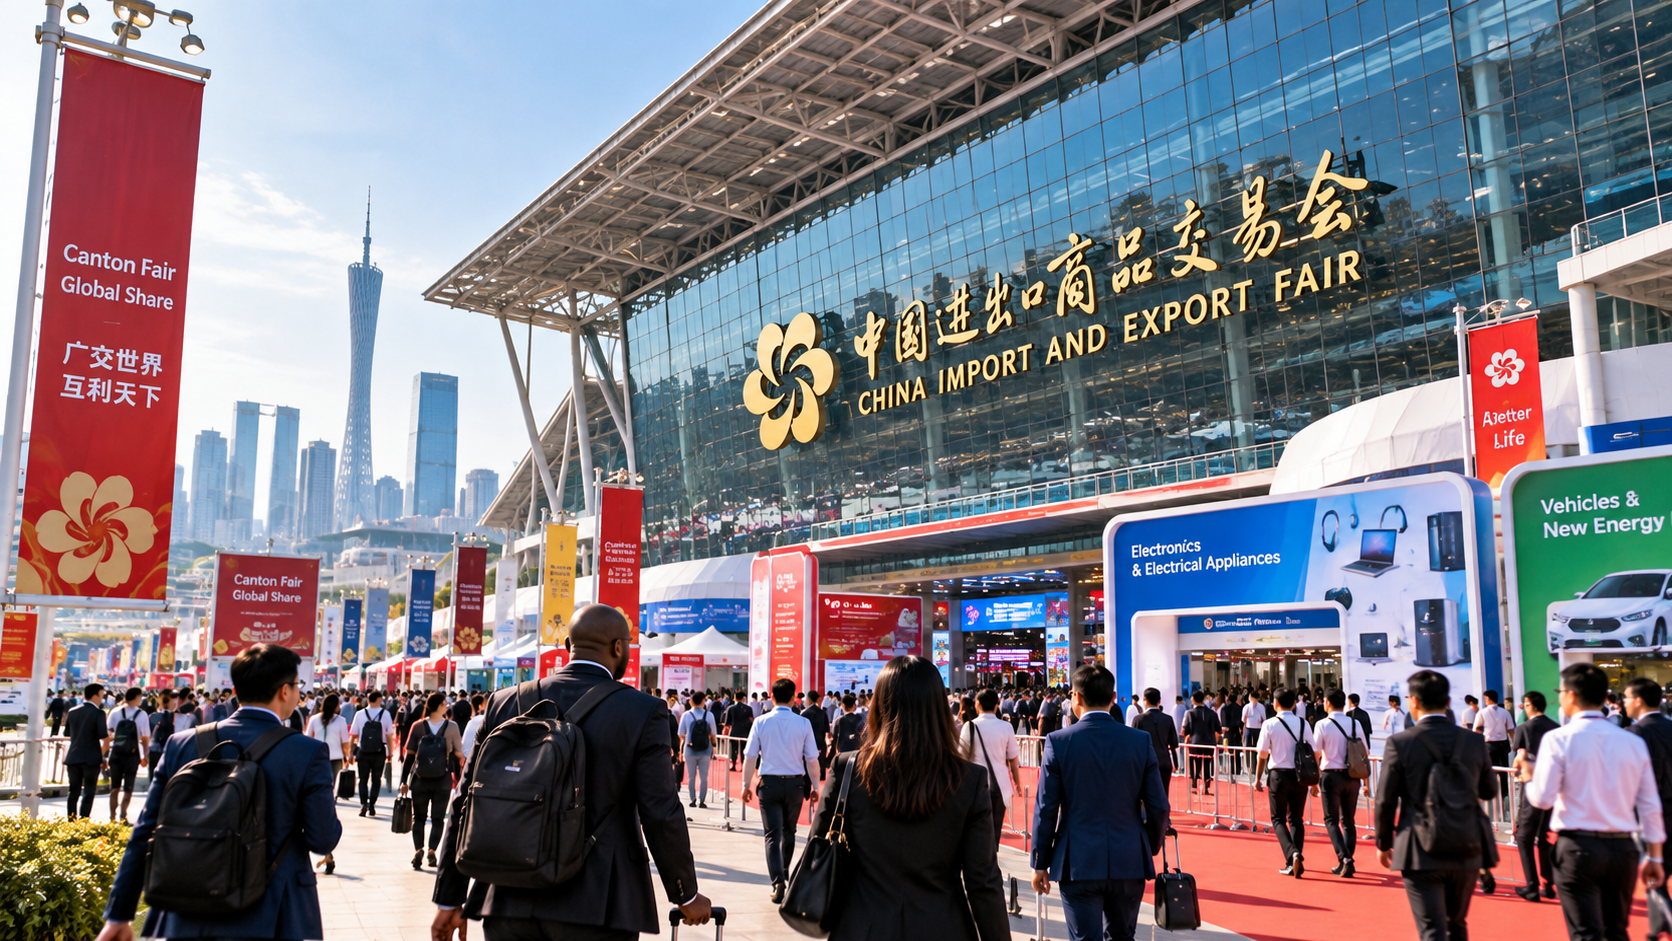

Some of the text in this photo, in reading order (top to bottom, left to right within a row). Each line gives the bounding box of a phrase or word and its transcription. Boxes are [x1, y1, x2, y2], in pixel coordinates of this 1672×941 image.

[63, 243, 177, 281] Canton Fair
[853, 149, 1370, 381] 中国进出口商品交易会
[60, 275, 174, 311] Global Share
[858, 249, 1363, 416] CHINA IMPORT AND EXPORT FAIR
[62, 340, 163, 377] 广交世界
[60, 373, 163, 409] 互利天下
[1540, 490, 1640, 515] Vehicles &
[1543, 520, 1588, 539] New
[1593, 515, 1665, 535] Energy
[1131, 540, 1202, 559] Electronics
[1132, 552, 1281, 577] & Electrical Appliances
[234, 573, 303, 588] Canton Fair
[232, 589, 302, 603] Global Share
